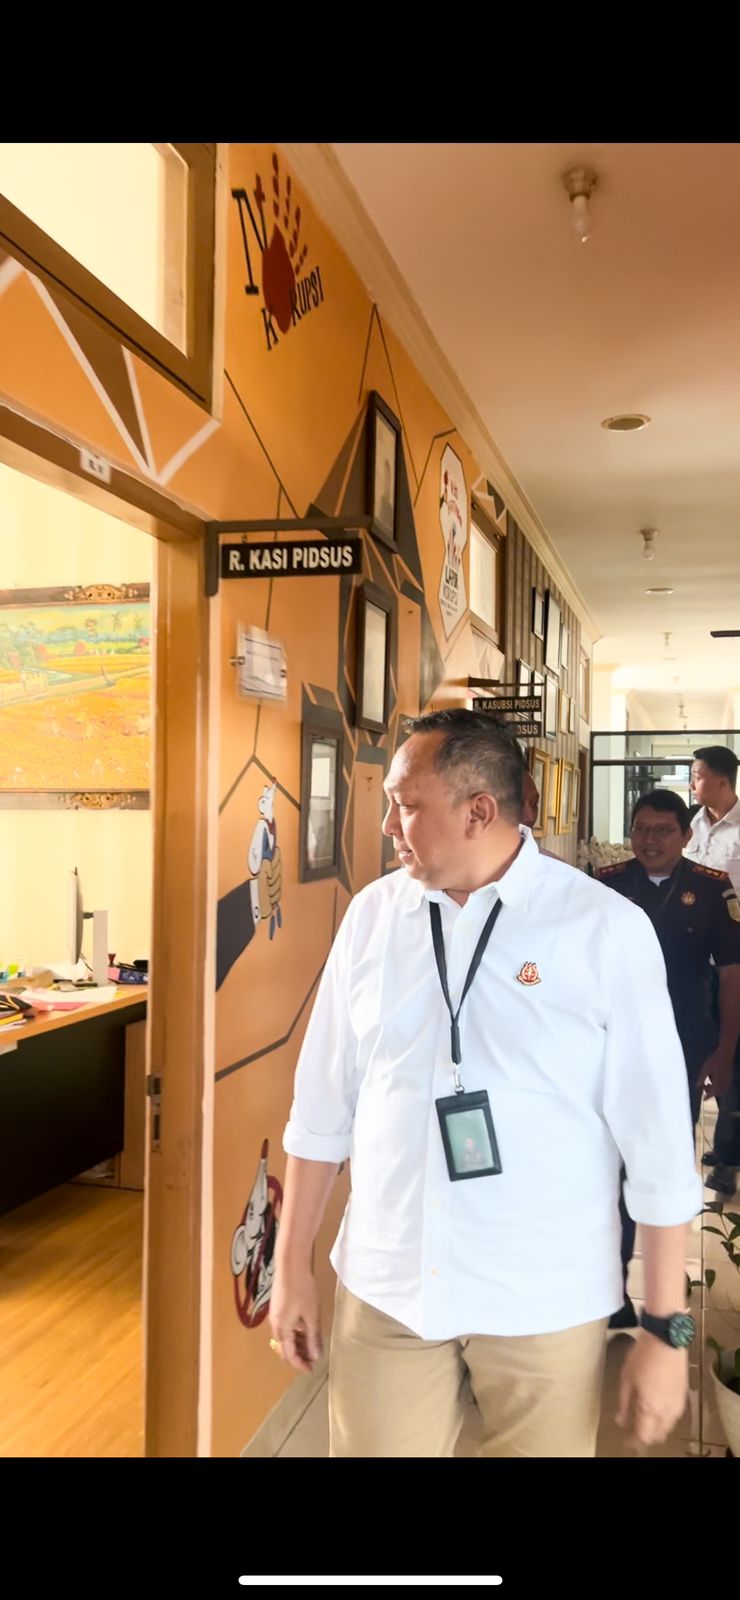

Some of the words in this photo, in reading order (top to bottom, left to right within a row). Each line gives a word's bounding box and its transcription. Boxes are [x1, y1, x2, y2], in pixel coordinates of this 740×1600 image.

[228, 550, 245, 571] R.
[249, 548, 288, 571] KASI
[292, 545, 353, 569] PIDSUS
[482, 700, 513, 710] KASUBSI
[514, 699, 540, 709] PIDSUS
